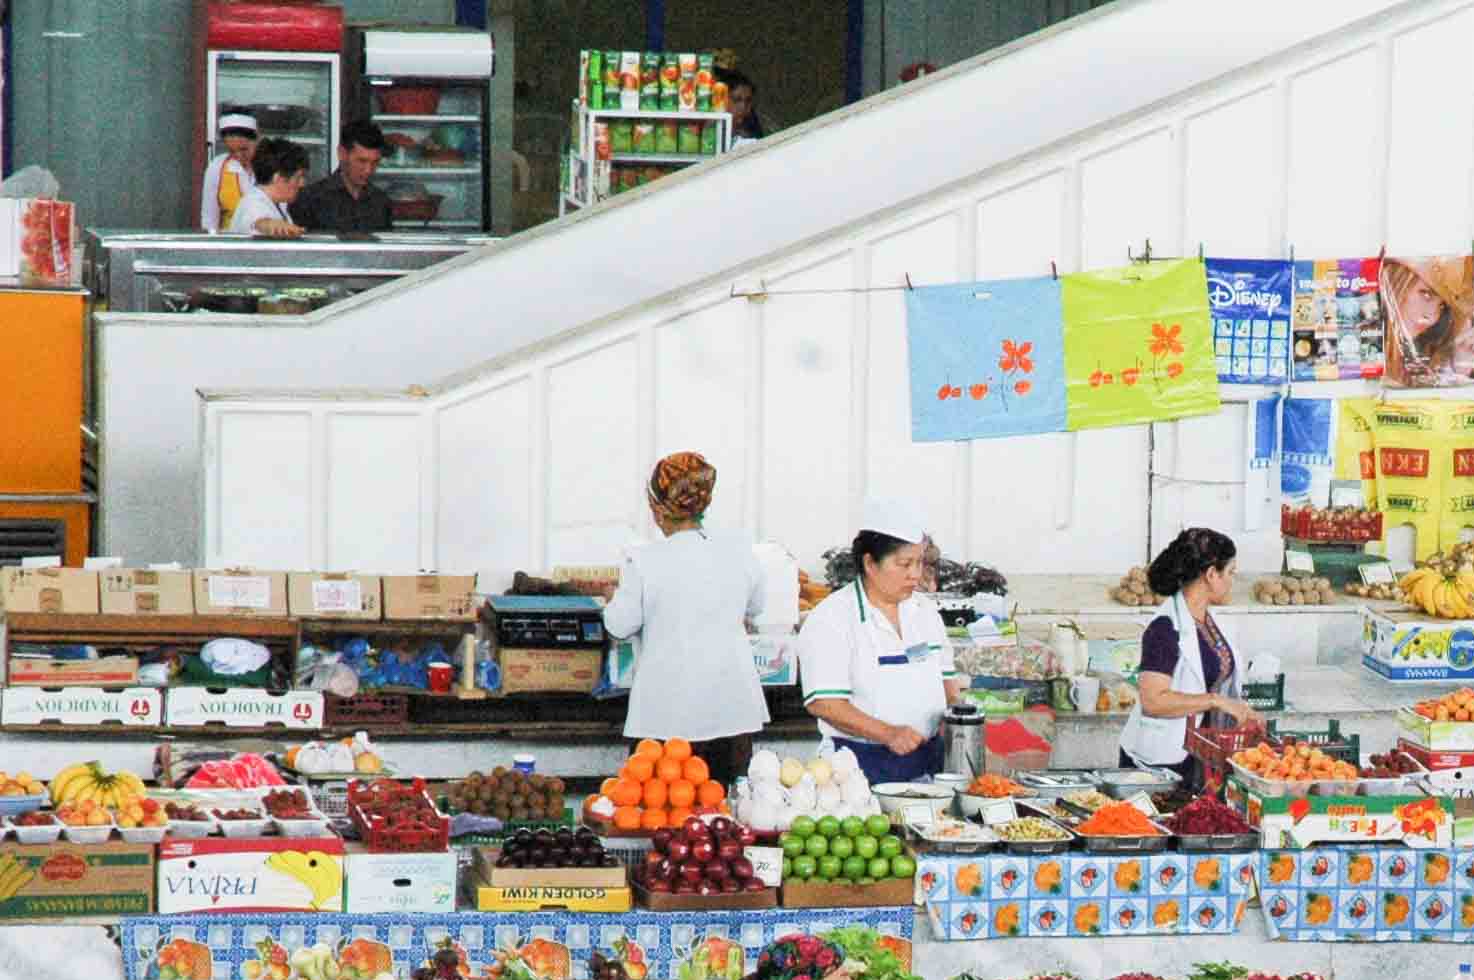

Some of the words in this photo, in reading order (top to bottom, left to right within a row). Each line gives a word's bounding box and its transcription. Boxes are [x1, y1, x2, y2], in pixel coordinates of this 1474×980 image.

[34, 699, 122, 714] TRADICION
[199, 701, 283, 717] TRADICION
[166, 874, 258, 897] PRIMA
[500, 886, 540, 900] KIWI
[542, 886, 607, 900] GOLDEN
